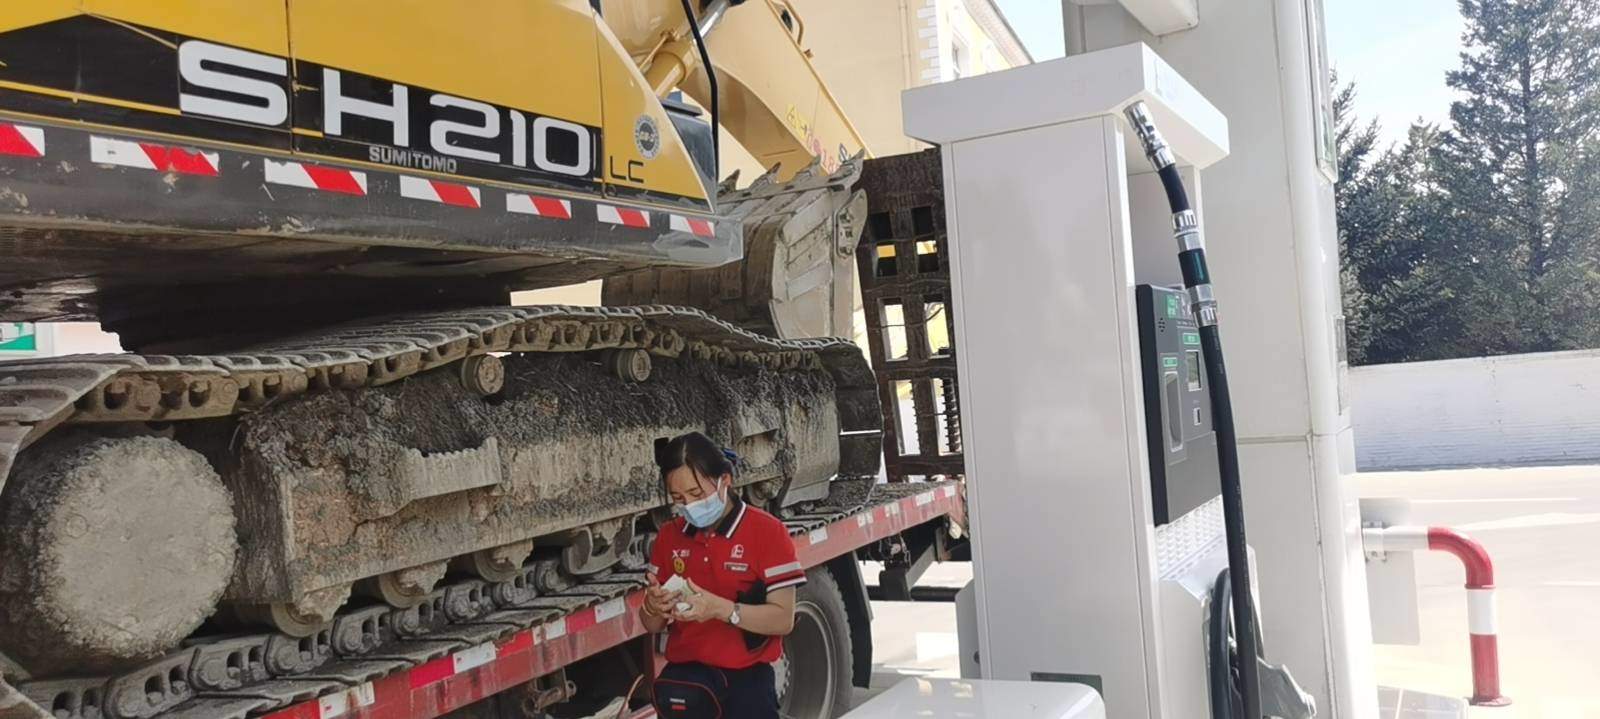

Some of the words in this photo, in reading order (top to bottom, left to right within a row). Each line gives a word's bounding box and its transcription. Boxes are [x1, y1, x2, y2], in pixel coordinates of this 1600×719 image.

[179, 41, 591, 176] SH210
[610, 156, 644, 183] LC
[369, 146, 457, 173] SUMITOMO
